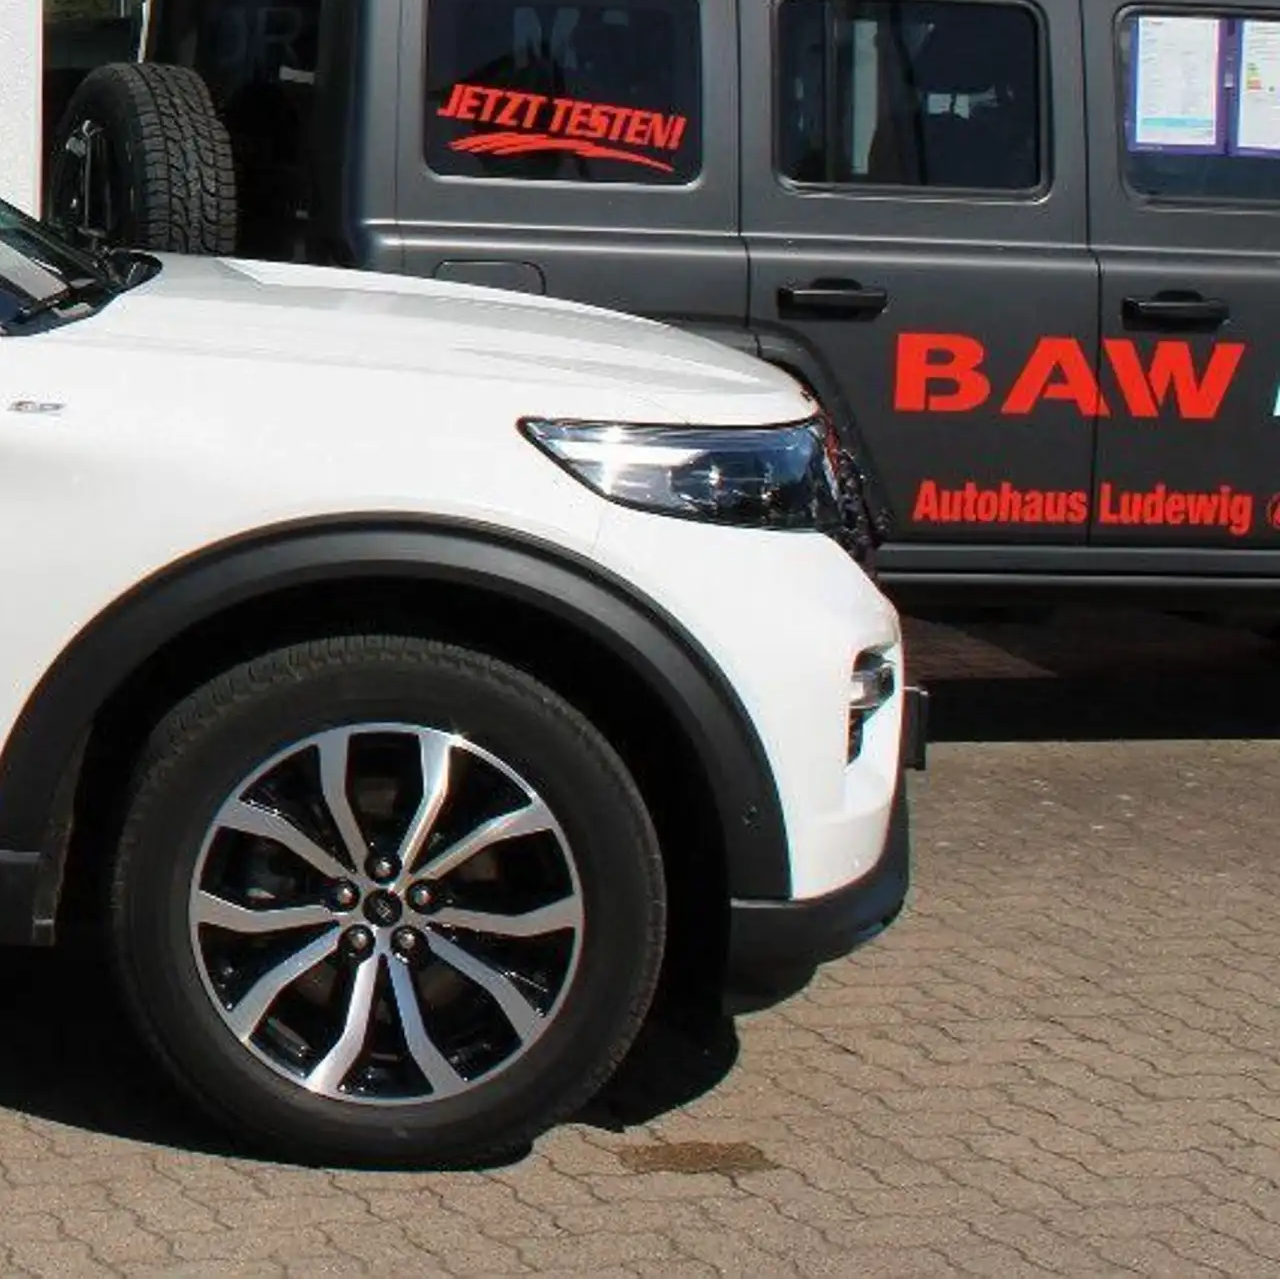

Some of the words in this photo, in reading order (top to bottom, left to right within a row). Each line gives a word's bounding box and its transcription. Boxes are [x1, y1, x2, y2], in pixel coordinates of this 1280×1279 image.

[436, 83, 547, 128] JETZT
[893, 332, 1245, 420] BAW
[912, 479, 1089, 524] Autohaus
[1098, 483, 1253, 536] Ludewig
